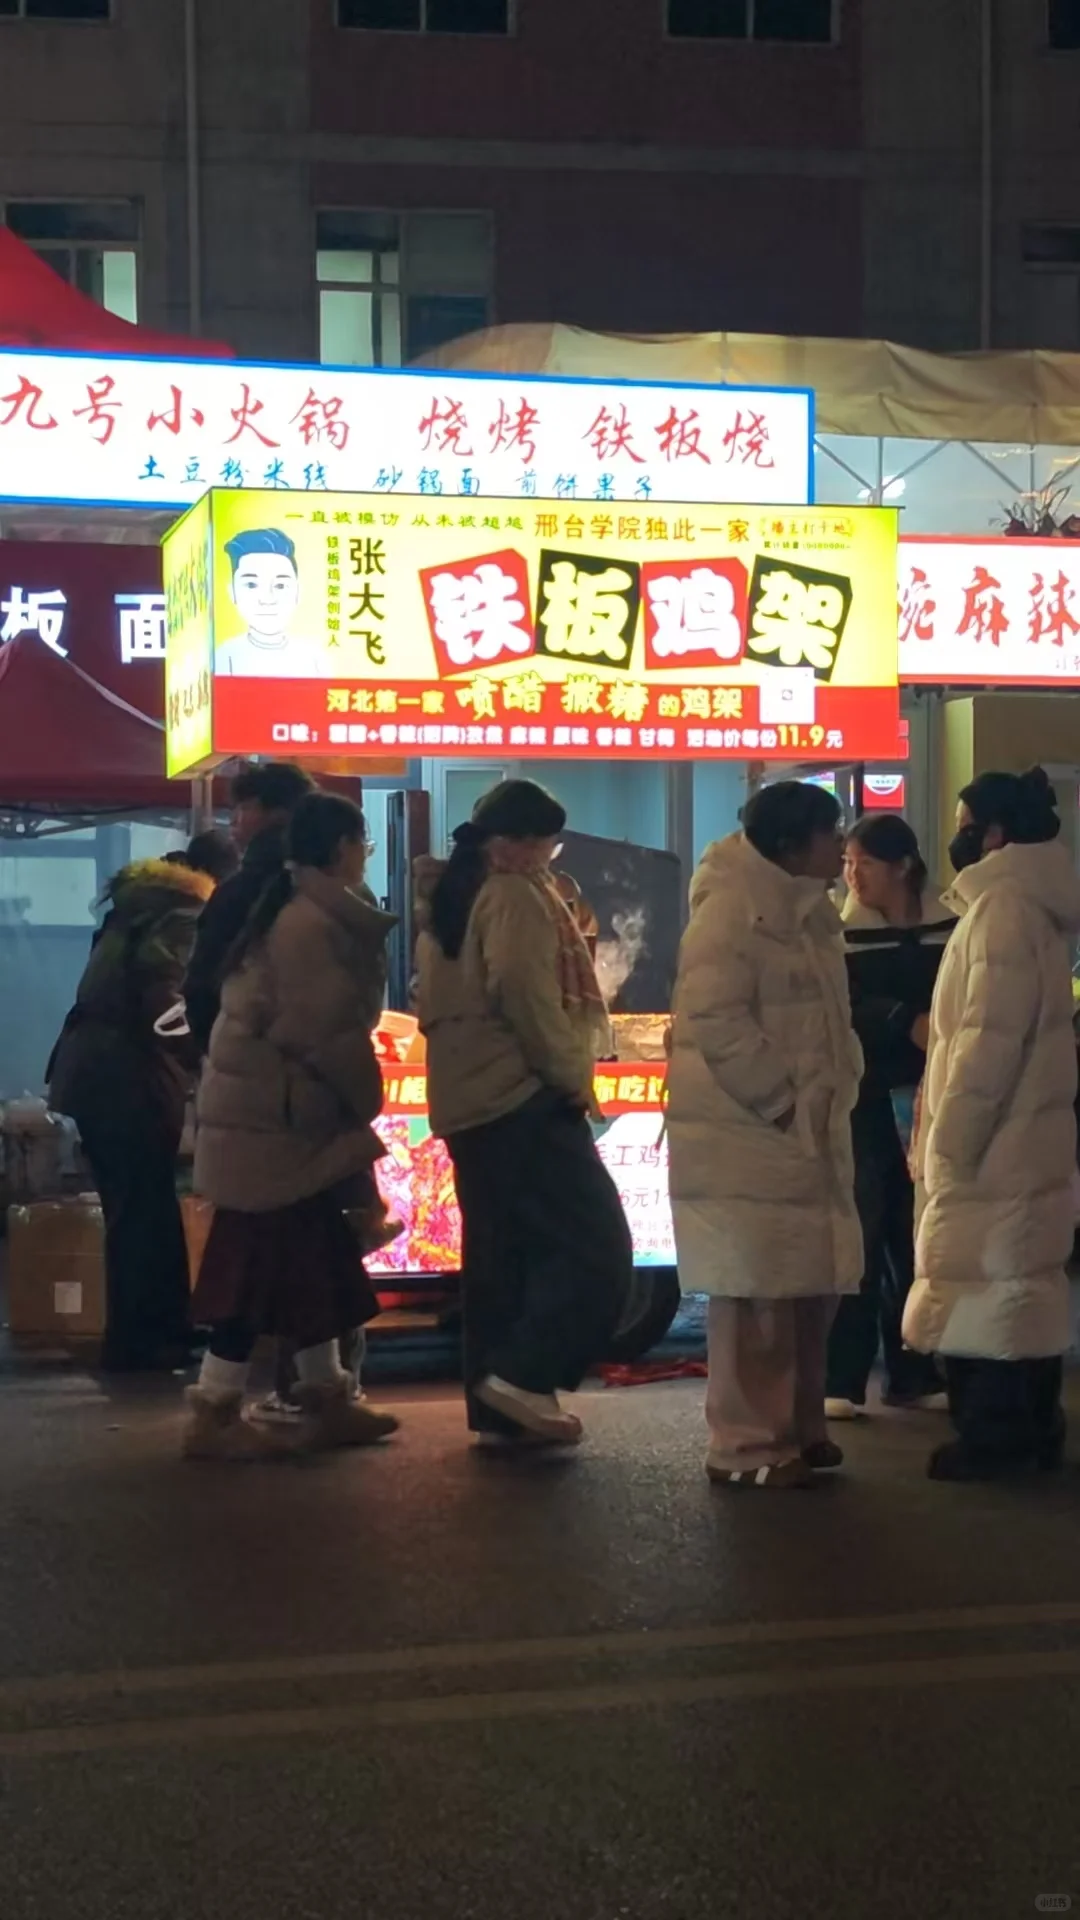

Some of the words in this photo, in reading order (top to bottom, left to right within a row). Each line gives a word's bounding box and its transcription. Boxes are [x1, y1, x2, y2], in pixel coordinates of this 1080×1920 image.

[0, 374, 350, 452] 九号小火锅
[418, 396, 541, 465] 烧烤
[582, 402, 775, 468] 铁板烧
[534, 513, 750, 543] 邢台学院独此一家
[0, 586, 166, 664] 板面
[348, 537, 387, 665] 张大飞
[429, 561, 846, 668] 铁板鸡架
[326, 688, 446, 714] 河北第一家
[658, 686, 743, 719] 的鸡架
[620, 1187, 670, 1209] 6元1
